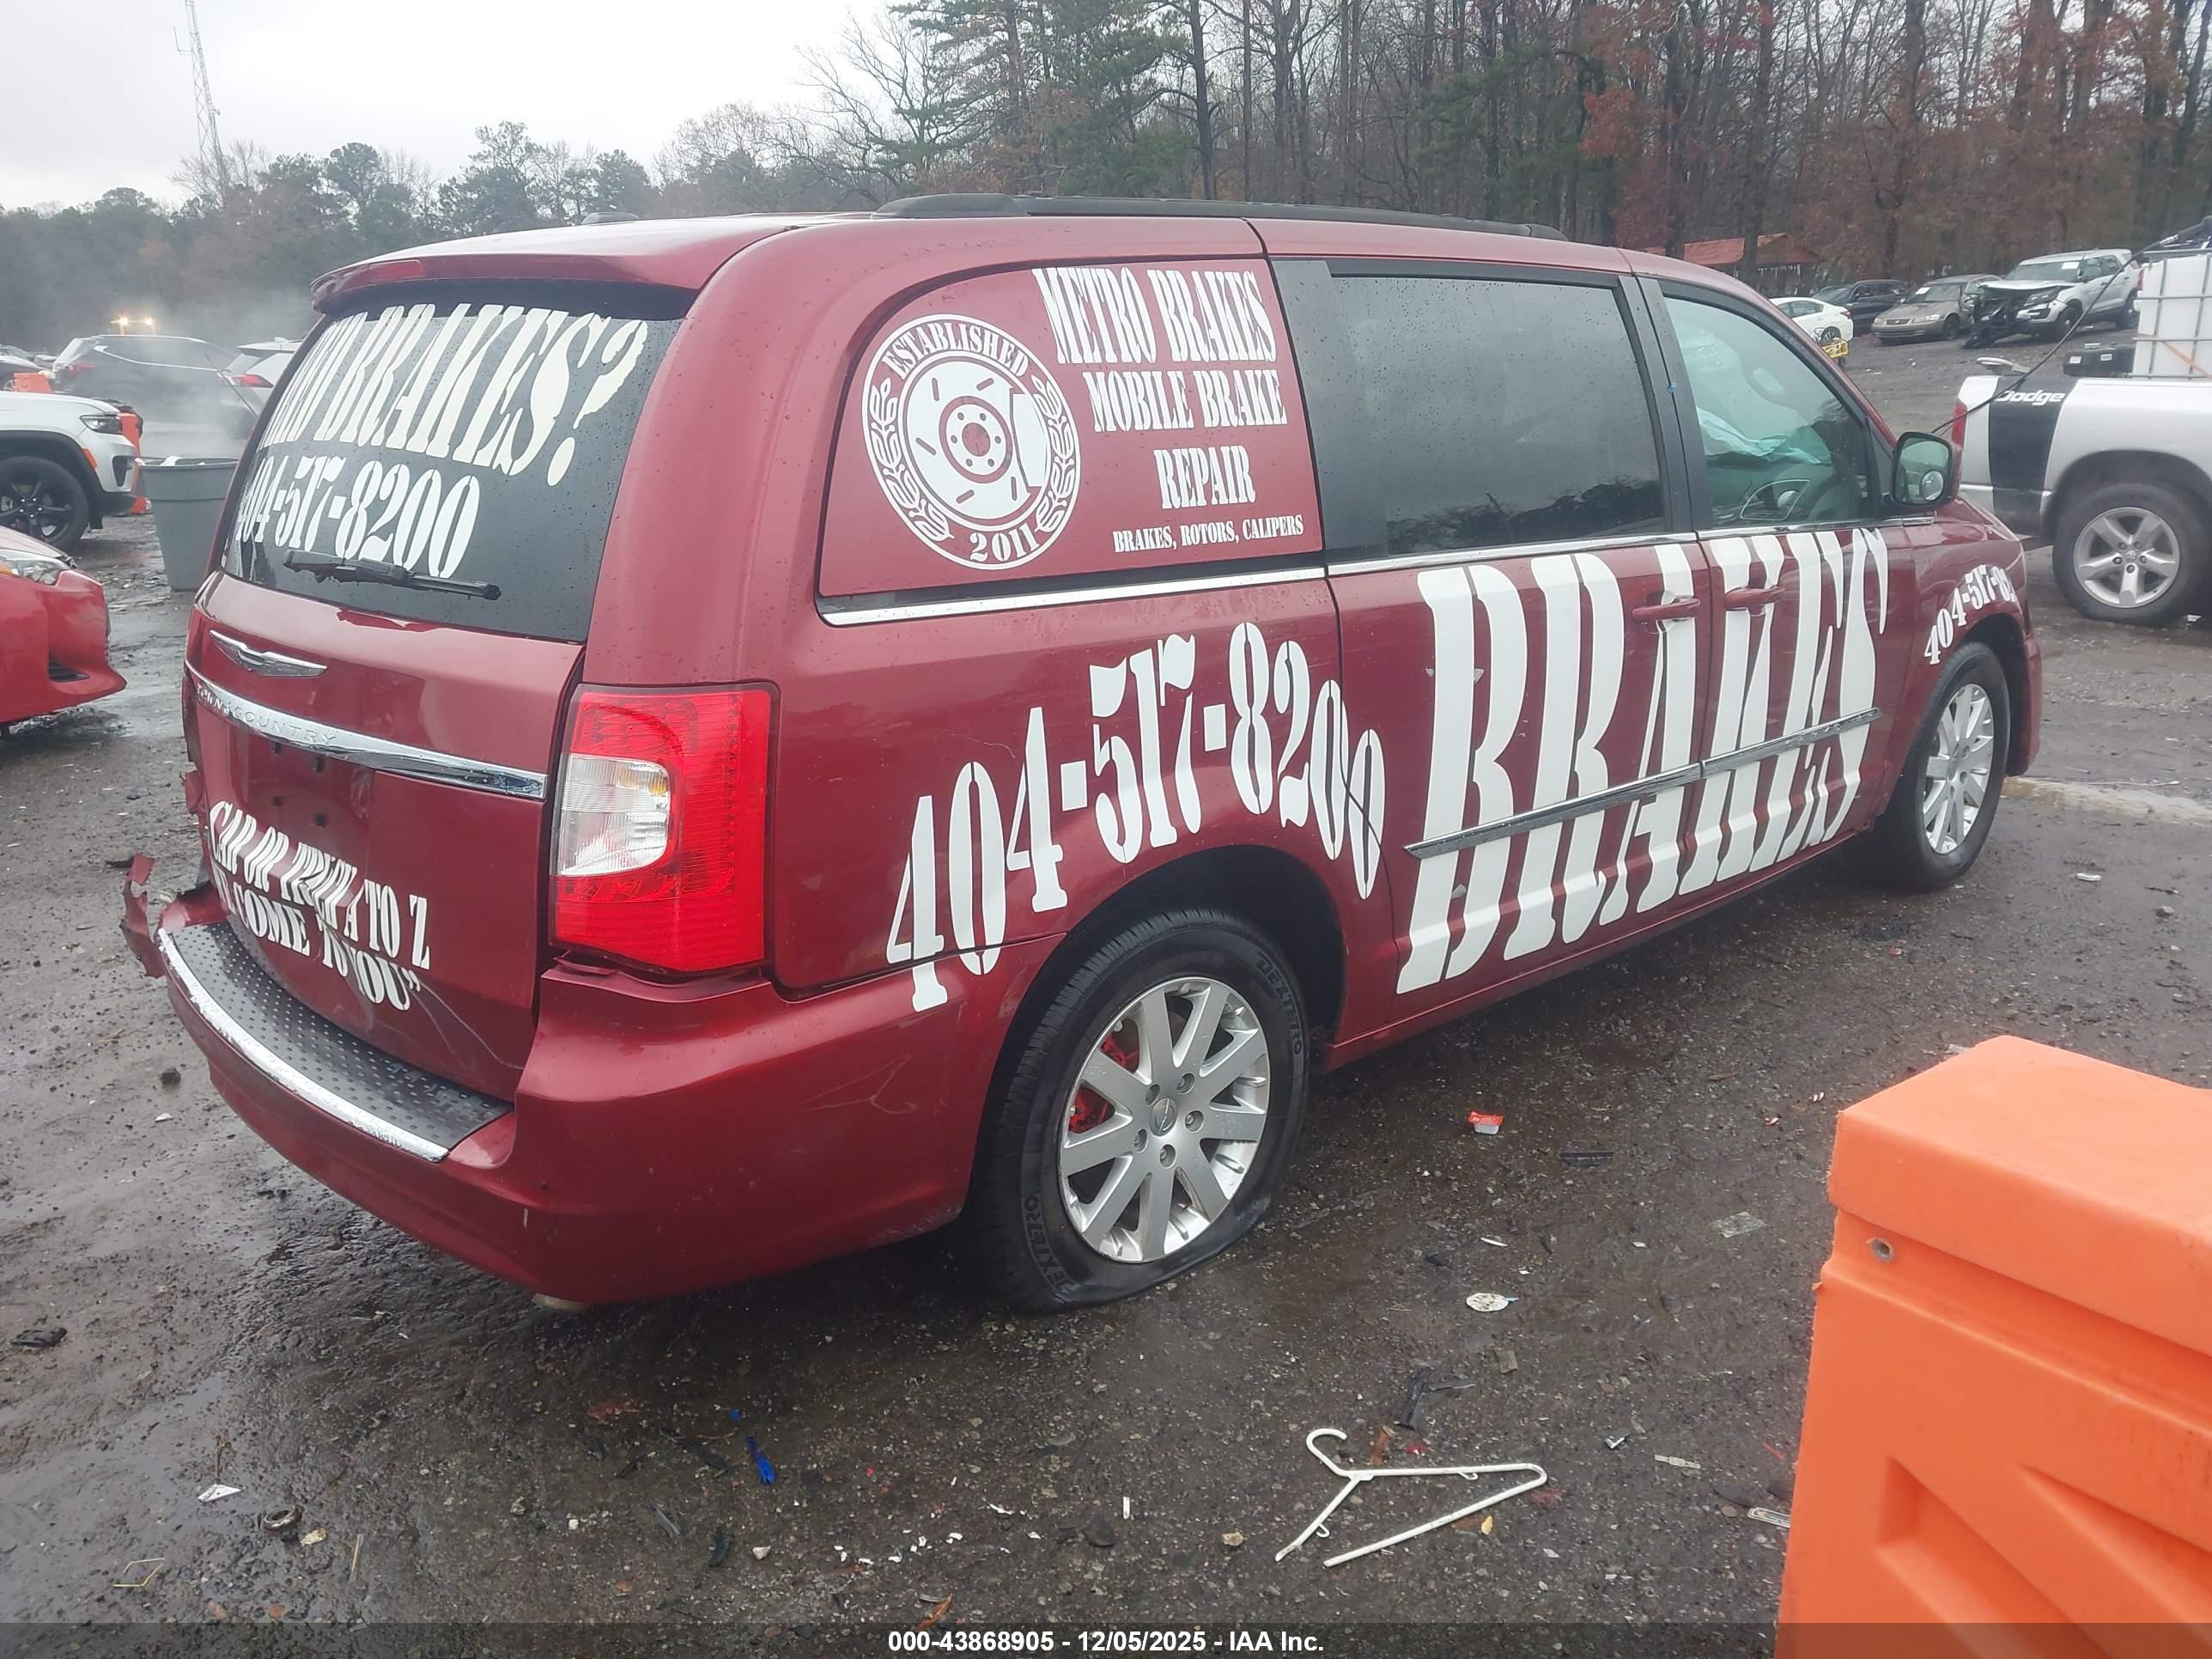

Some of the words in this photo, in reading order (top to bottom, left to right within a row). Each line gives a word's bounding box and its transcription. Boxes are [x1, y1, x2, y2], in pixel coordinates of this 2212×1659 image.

[1032, 267, 1157, 364] METRO
[1146, 269, 1278, 363] BRAKES
[882, 322, 1029, 380] ESTABLISHED
[313, 303, 648, 486] BRAKES?
[1083, 369, 1194, 433] MOBILE
[1192, 368, 1288, 428] BRAKE
[1994, 390, 2066, 406] Dodge
[1153, 445, 1255, 509] REPAIR
[235, 454, 480, 578] 404-517-8200
[969, 522, 1040, 562] 2011
[1113, 526, 1177, 553] BRAKES,
[1180, 520, 1239, 546] ROTORS,
[1242, 514, 1304, 540] CALIPERS
[233, 707, 337, 744] COUNTRY
[1396, 527, 1887, 994] BRAKES
[886, 622, 1386, 1012] 404-517-8200
[210, 801, 257, 874] CAR
[244, 826, 289, 893] OR
[343, 883, 365, 942] A
[364, 878, 400, 958] TO
[409, 894, 430, 969] Z
[233, 881, 310, 957] COME
